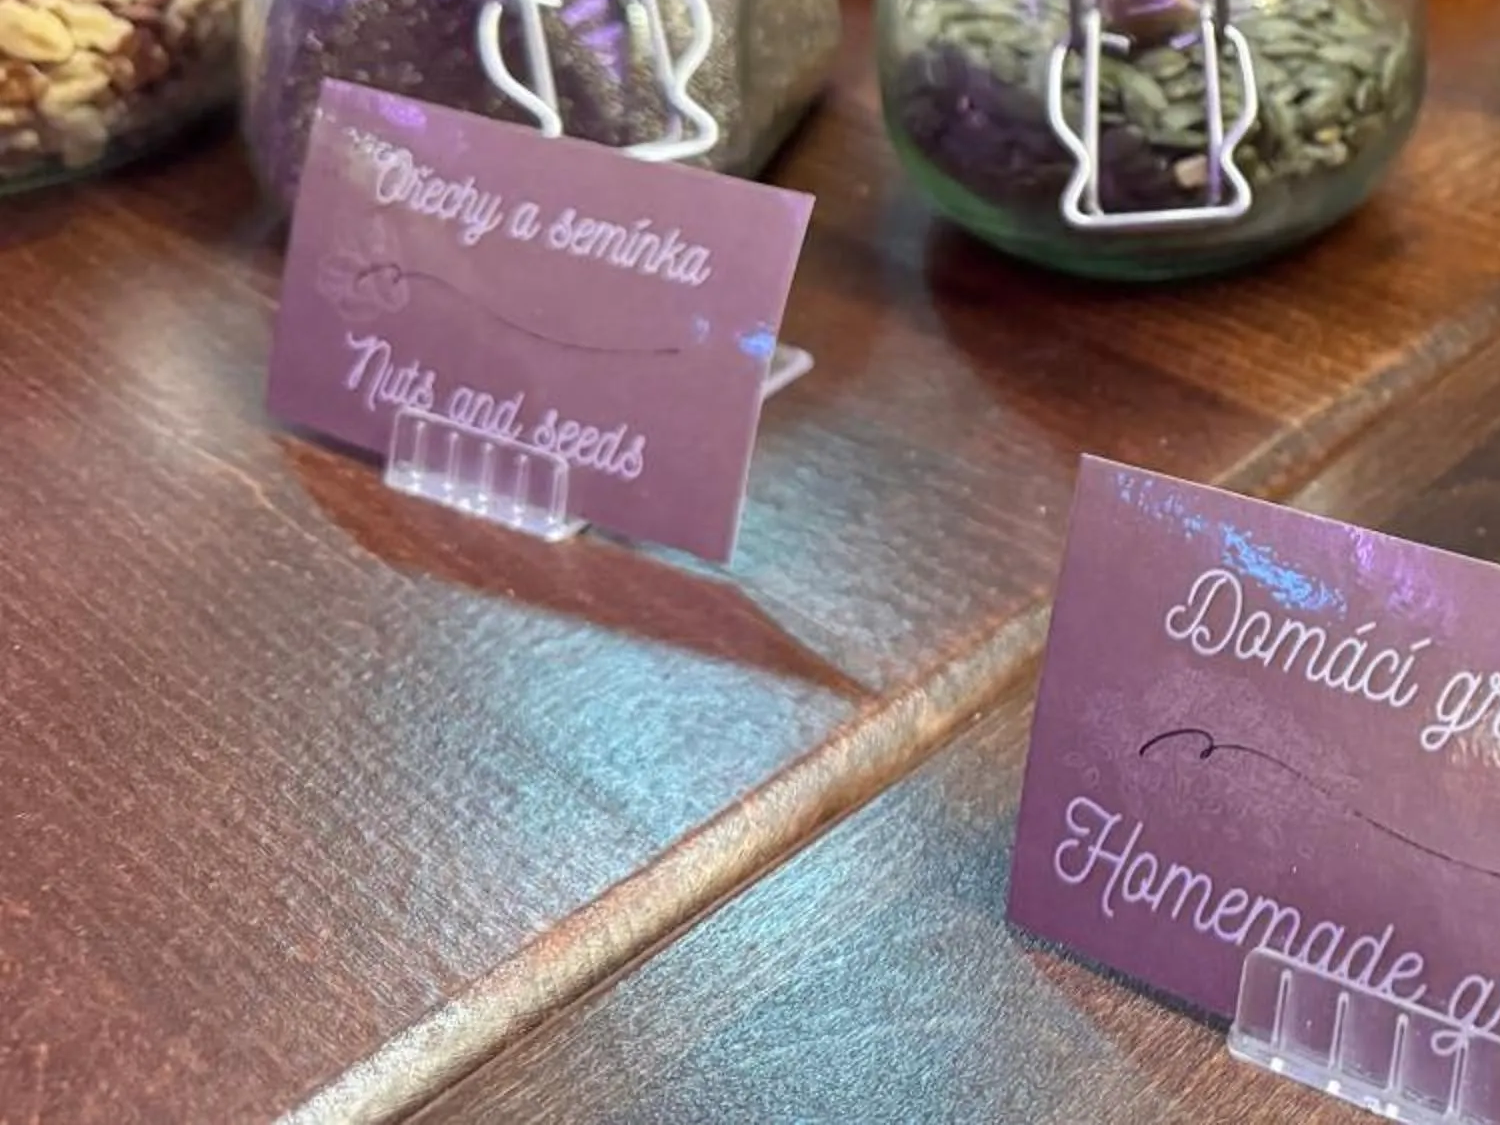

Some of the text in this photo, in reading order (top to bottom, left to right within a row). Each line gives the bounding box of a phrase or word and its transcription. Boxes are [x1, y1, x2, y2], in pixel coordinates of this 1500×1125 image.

[509, 201, 541, 241] a
[550, 207, 712, 286] semínka
[345, 331, 647, 480] Nuts and seeds
[1164, 567, 1431, 708] Domácí
[1054, 795, 1428, 1003] Homemade
